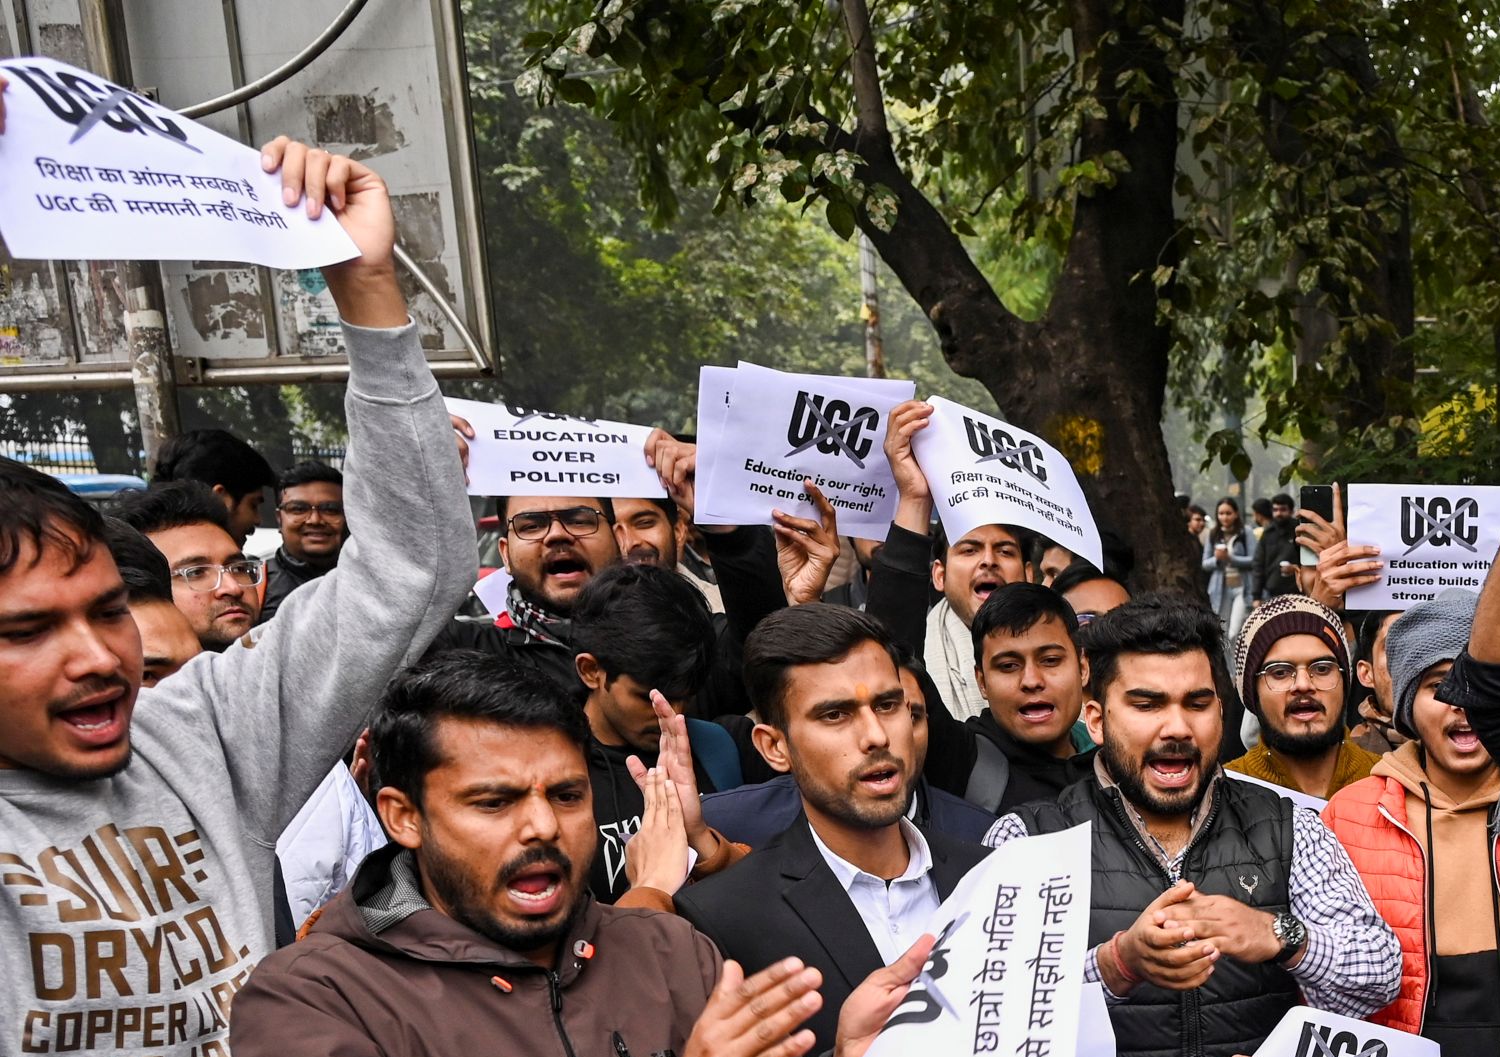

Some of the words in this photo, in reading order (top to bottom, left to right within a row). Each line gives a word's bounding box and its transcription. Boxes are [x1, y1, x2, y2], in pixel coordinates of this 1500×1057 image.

[35, 157, 93, 183] शिक्षा
[95, 167, 125, 184] का
[132, 166, 185, 189] आंगन
[37, 194, 84, 212] UGC
[86, 193, 117, 213] की
[124, 198, 201, 218] मनमानी
[204, 202, 238, 222] नहीं
[237, 205, 289, 229] चलेगी
[494, 430, 628, 444] EDUCATION
[787, 390, 879, 460] UGC
[532, 451, 596, 463] OVER
[963, 415, 1047, 483] UGC
[510, 471, 621, 484] POLITICS!
[750, 481, 773, 495] not
[777, 489, 794, 500] an
[815, 474, 826, 486] is
[828, 479, 851, 491] our
[852, 481, 886, 498] right,
[951, 471, 983, 486] शिक्षा
[985, 474, 1001, 486] का
[1004, 478, 1032, 498] आंगन
[948, 491, 969, 508] UGC
[972, 487, 989, 498] की
[995, 490, 1034, 512] मनमानी
[1036, 507, 1054, 522] नहीं
[1056, 516, 1083, 537] चलेगी
[1401, 497, 1478, 547] UGC
[1387, 575, 1434, 586] justice
[1439, 577, 1478, 586] builds
[1390, 560, 1457, 569] Education
[1462, 560, 1491, 570] with
[1038, 875, 1073, 926] नहीं!
[983, 884, 1021, 953] भविष्य
[973, 959, 1006, 983] के
[21, 1001, 188, 1053] COPPER
[969, 990, 1004, 1055] छात्रों
